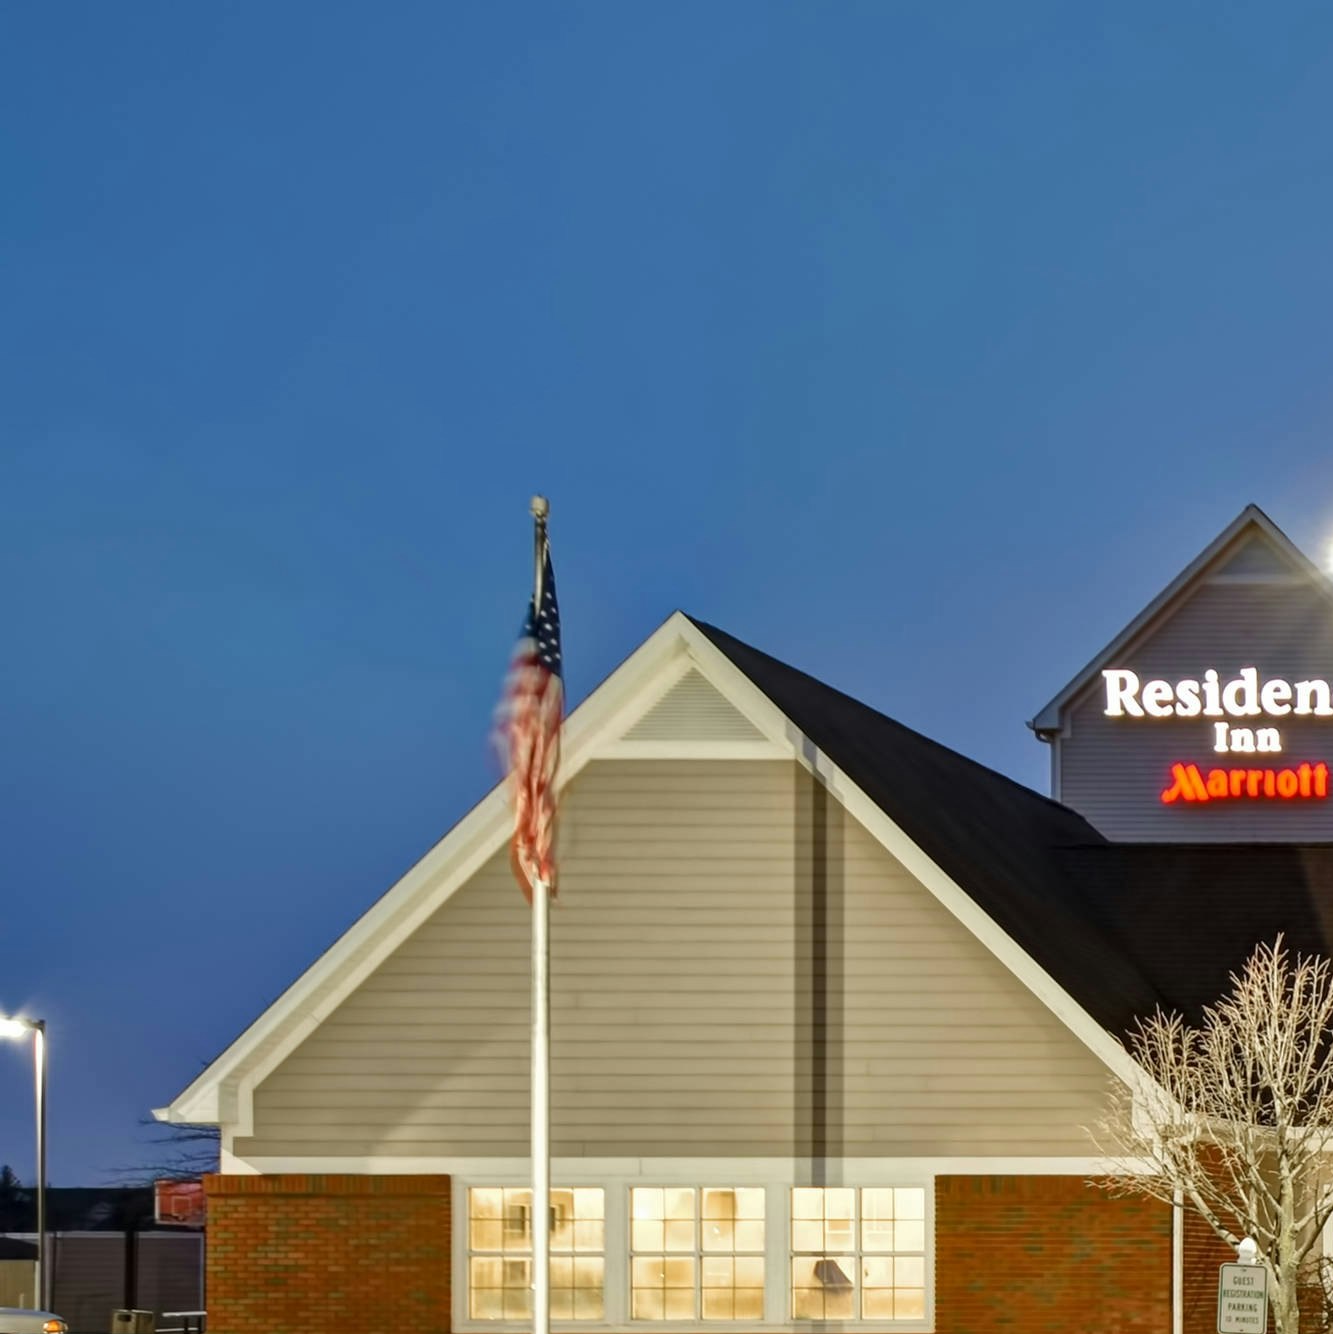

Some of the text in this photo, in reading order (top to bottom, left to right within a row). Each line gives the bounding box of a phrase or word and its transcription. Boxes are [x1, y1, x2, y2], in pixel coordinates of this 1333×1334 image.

[1214, 721, 1282, 752] Inn
[1161, 762, 1329, 803] Marriott
[1233, 1276, 1254, 1286] GUEST
[1228, 1302, 1258, 1313] PARKING
